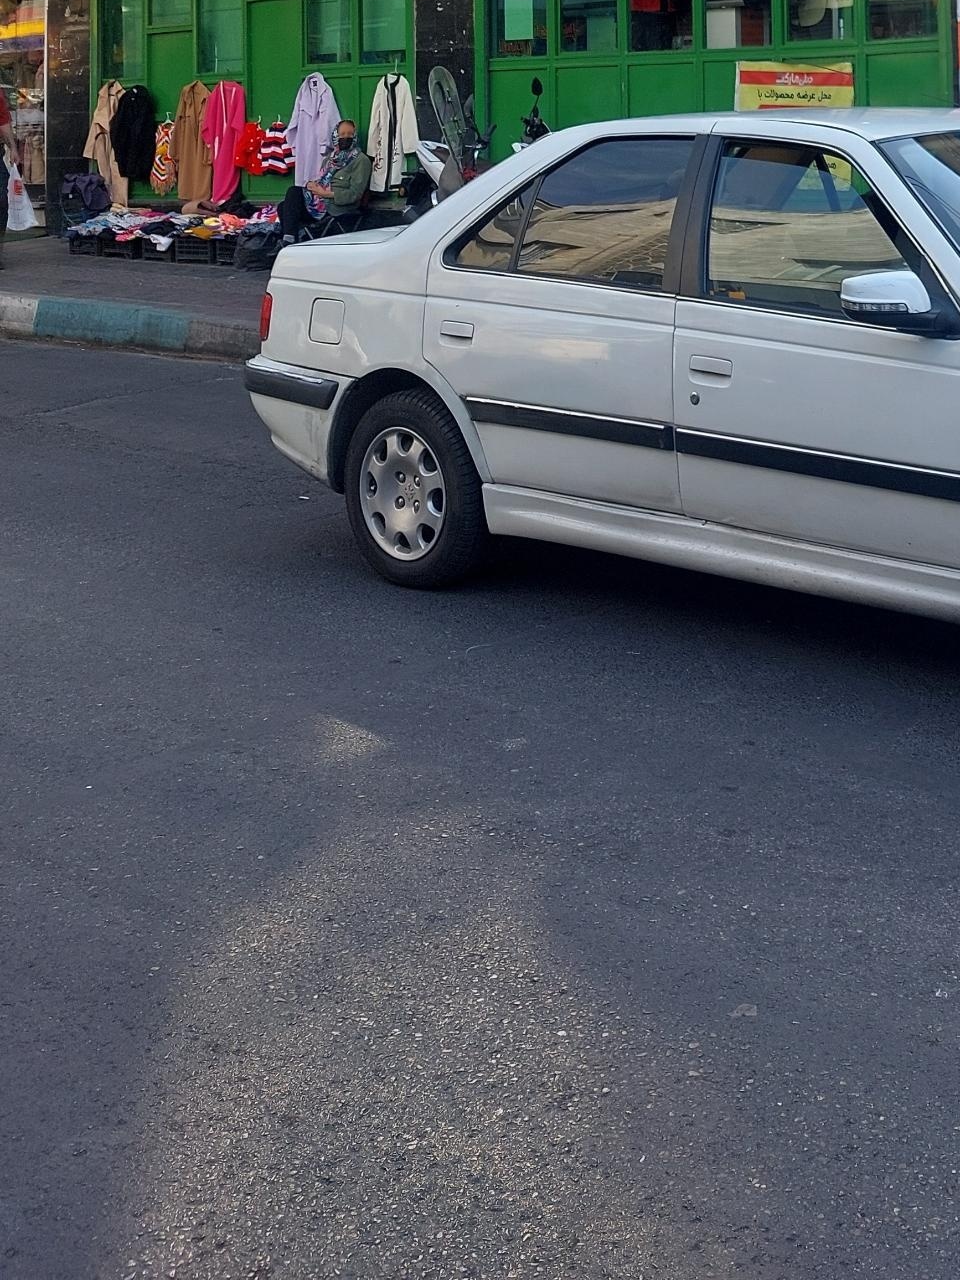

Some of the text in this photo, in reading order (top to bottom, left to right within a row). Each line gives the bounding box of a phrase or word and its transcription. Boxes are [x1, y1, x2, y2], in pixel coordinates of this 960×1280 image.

[764, 89, 795, 101] محصولات
[797, 90, 816, 102] عرضه
[817, 90, 832, 102] محل
